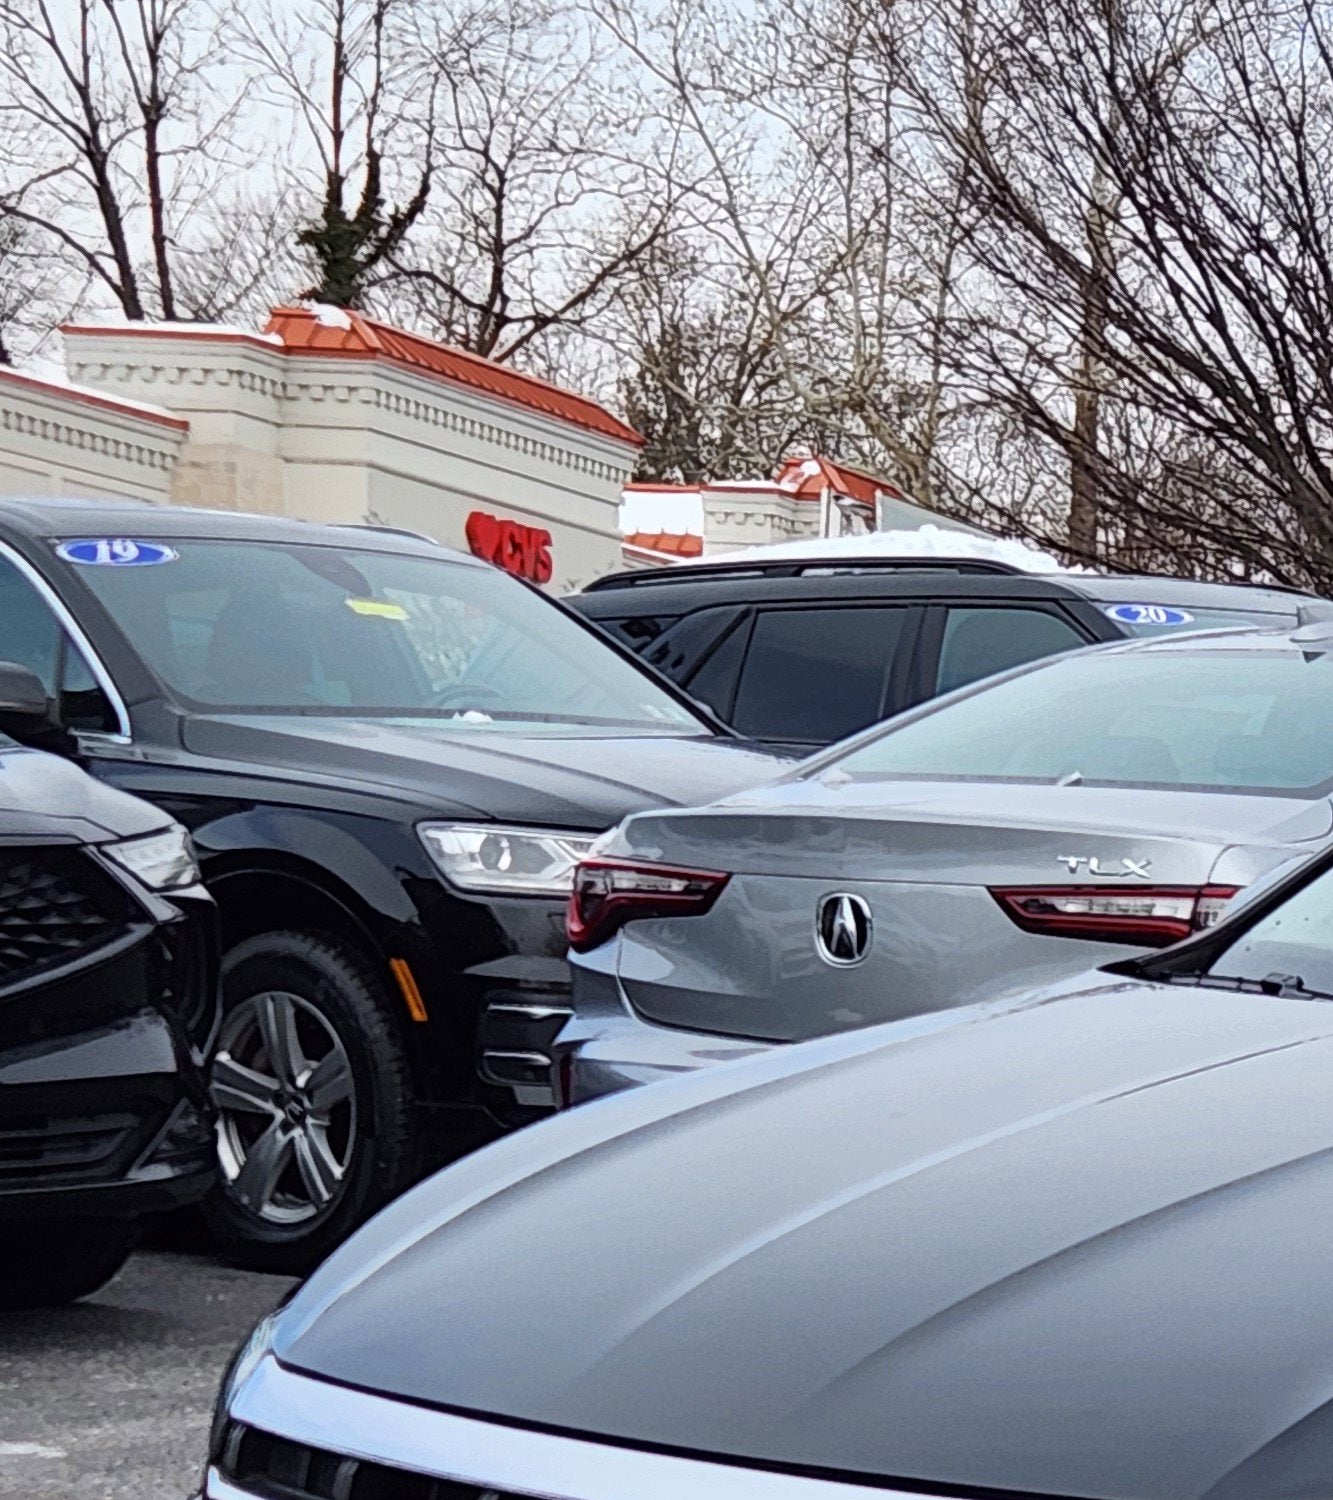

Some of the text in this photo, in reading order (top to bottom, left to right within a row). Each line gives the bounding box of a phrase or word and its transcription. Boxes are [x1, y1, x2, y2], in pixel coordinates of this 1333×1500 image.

[96, 539, 139, 562] 19
[493, 519, 553, 585] CVS
[1133, 606, 1167, 623] 20
[1056, 855, 1152, 879] TLX
